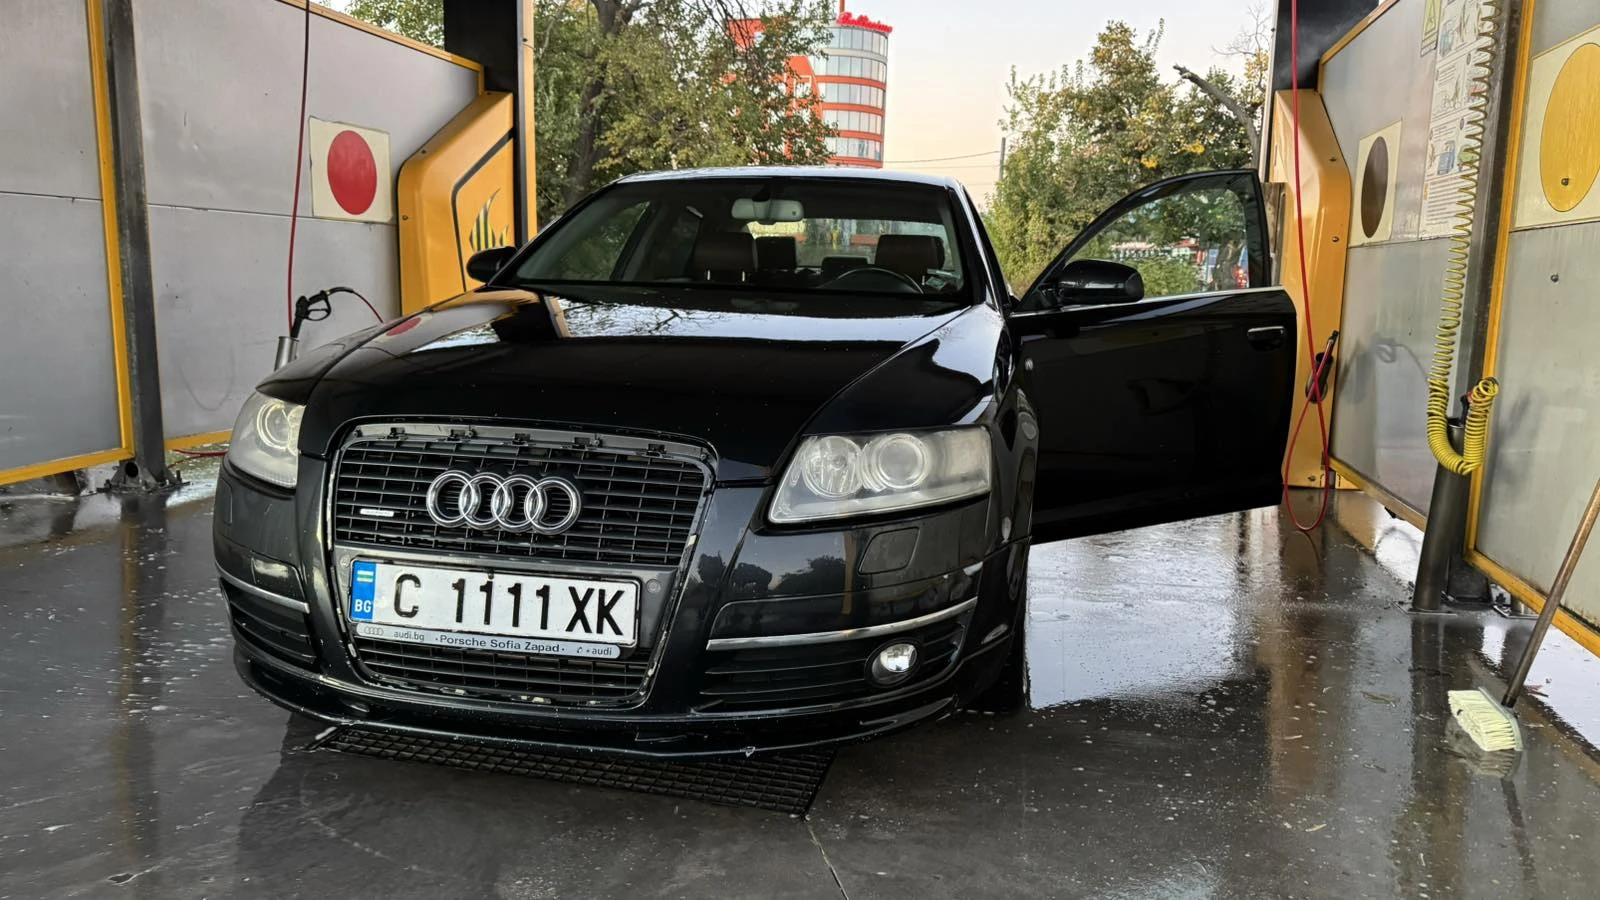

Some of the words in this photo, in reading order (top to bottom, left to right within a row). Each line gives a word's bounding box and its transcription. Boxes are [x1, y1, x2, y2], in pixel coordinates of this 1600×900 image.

[355, 599, 372, 613] BG
[393, 573, 421, 619] C
[452, 578, 551, 630] 1111
[565, 586, 625, 636] XK
[393, 630, 425, 643] audi.bg
[440, 634, 487, 648] Porsche
[490, 639, 521, 650] Sofia
[524, 641, 560, 654] Zapad
